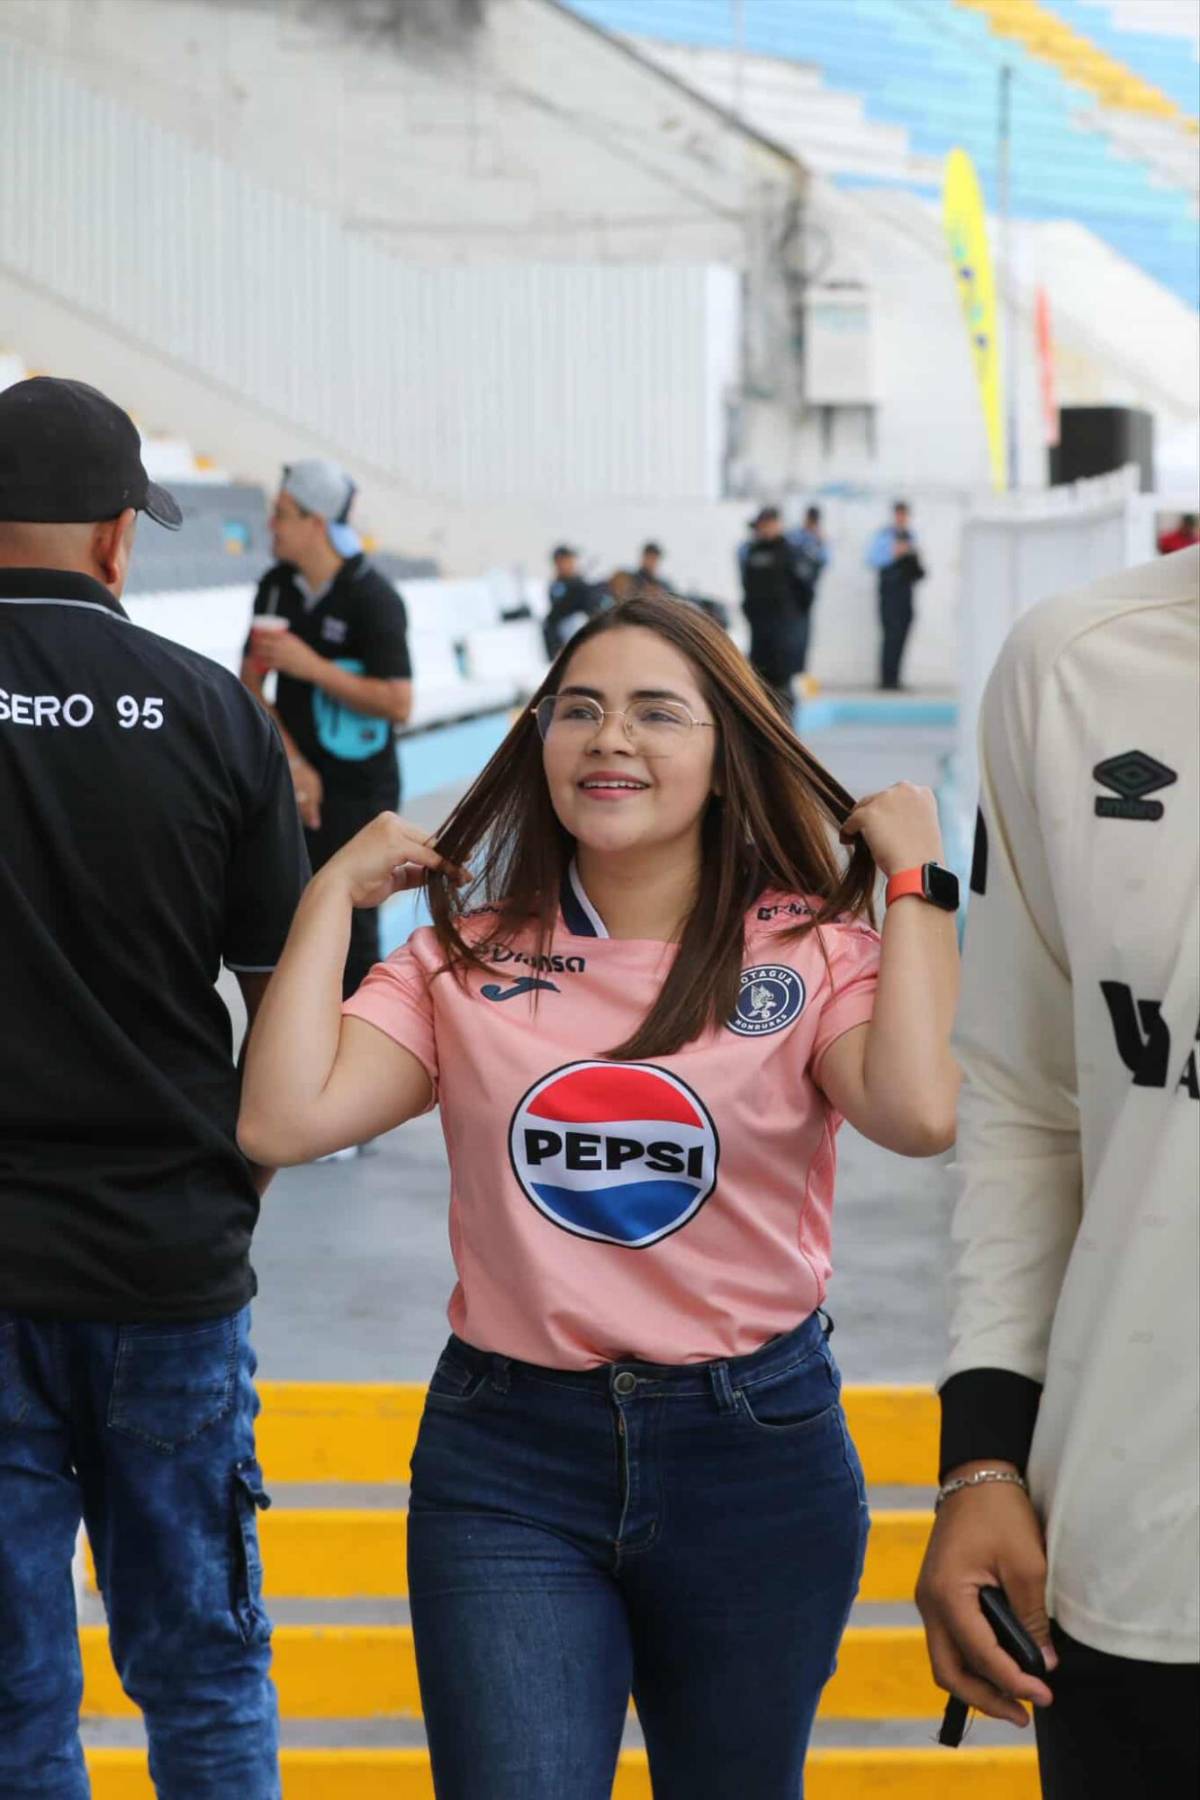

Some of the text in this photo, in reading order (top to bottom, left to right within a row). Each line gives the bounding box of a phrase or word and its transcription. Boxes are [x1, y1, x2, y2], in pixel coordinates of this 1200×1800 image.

[116, 695, 164, 729] 95
[739, 970, 793, 986] OTAGUA
[524, 1129, 704, 1179] PEPSI
